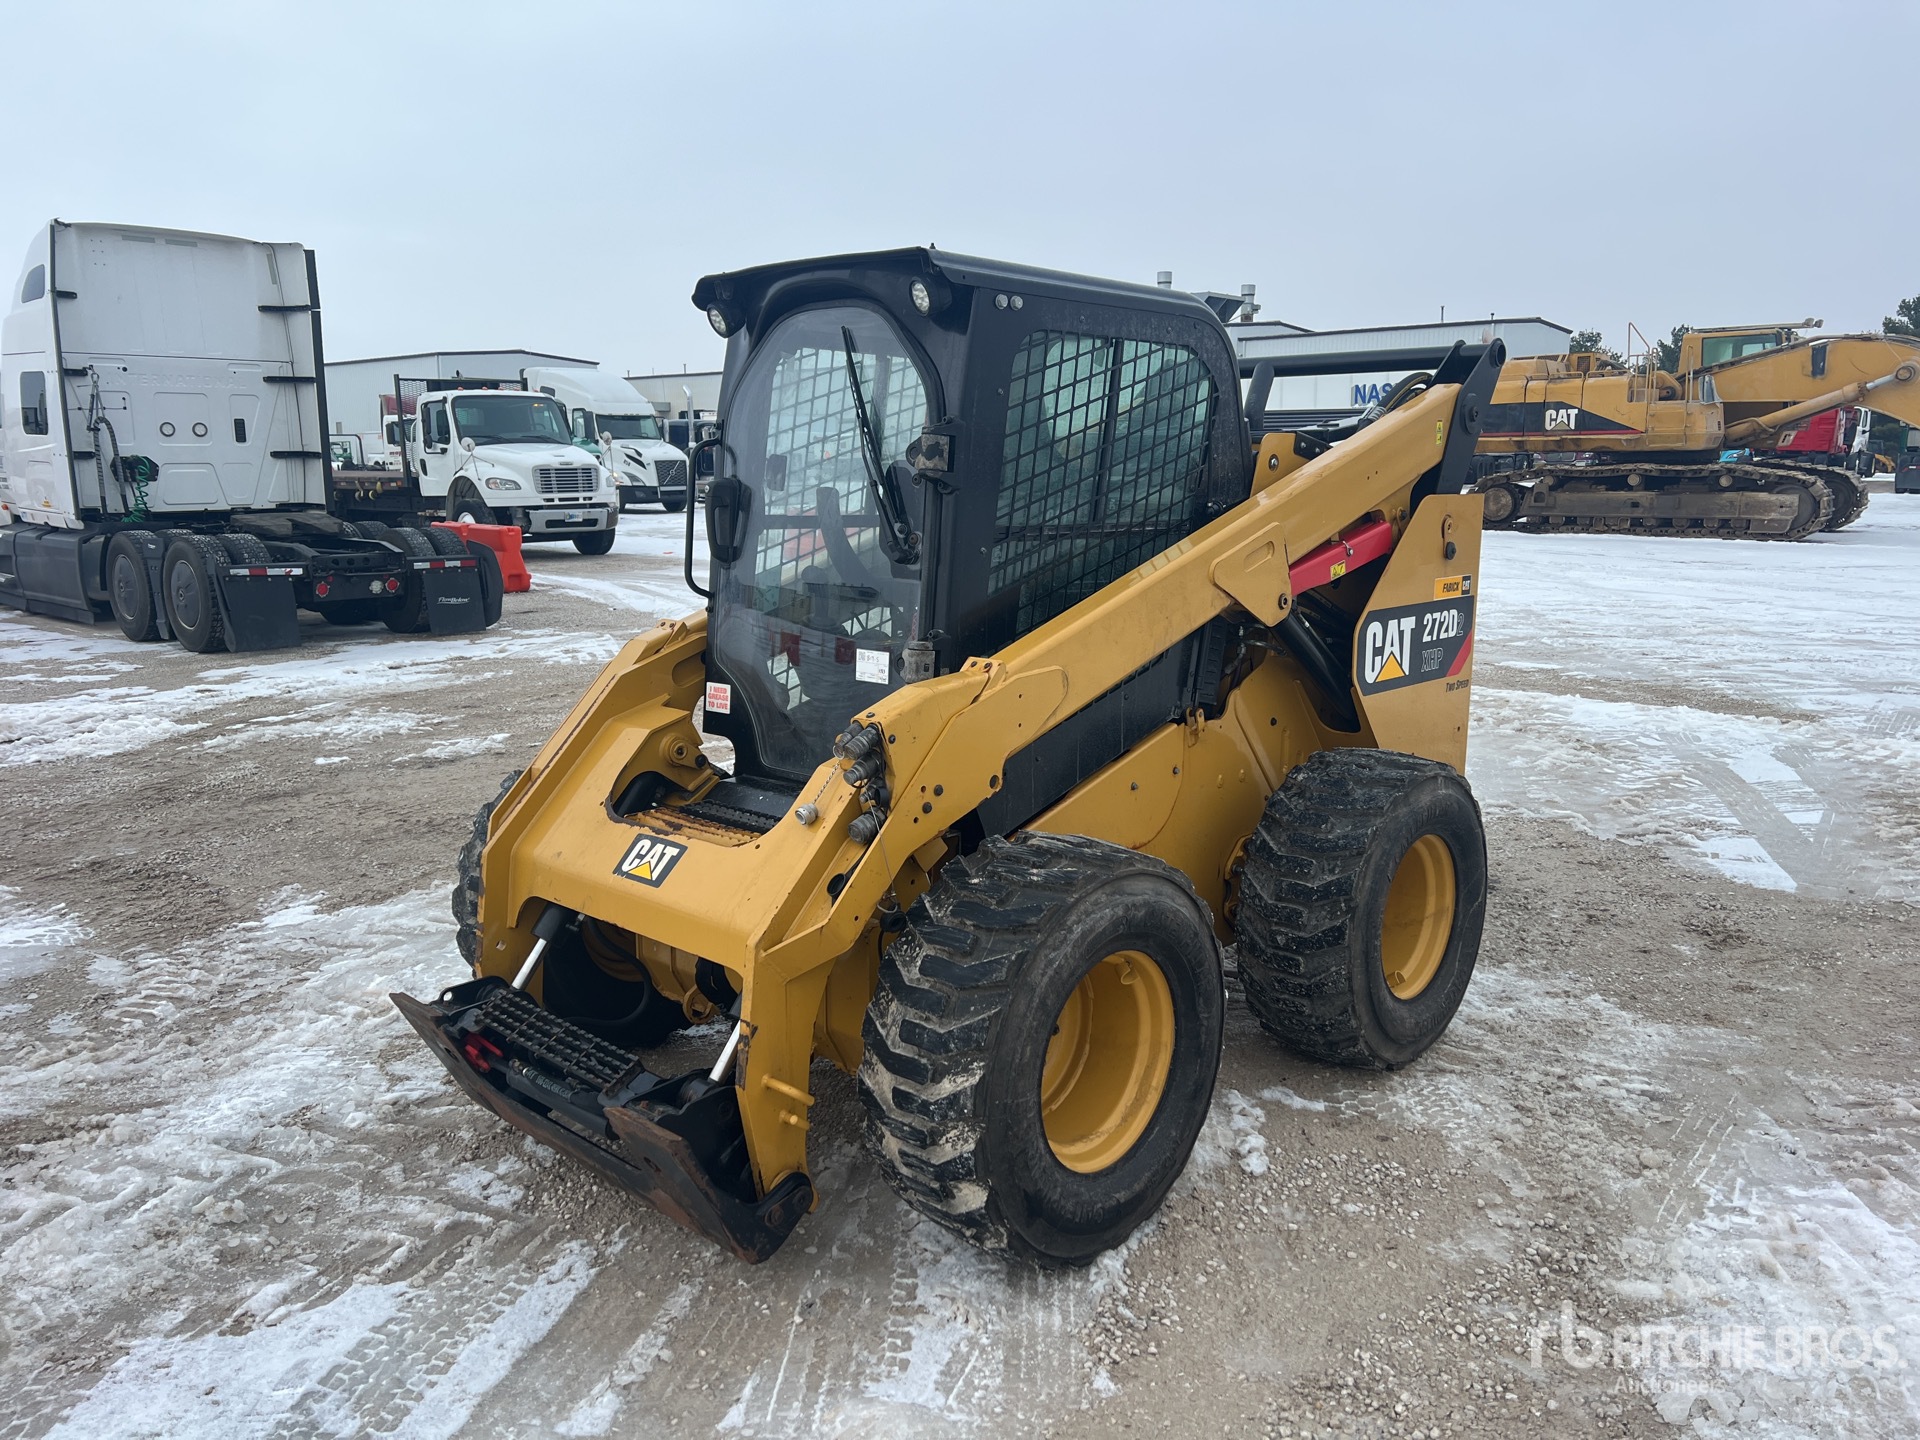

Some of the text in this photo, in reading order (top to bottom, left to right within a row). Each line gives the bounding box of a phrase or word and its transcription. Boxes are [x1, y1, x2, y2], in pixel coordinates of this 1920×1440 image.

[1544, 408, 1578, 431] CAT
[1462, 580, 1470, 591] CAT
[1364, 616, 1416, 684] CAT
[1421, 647, 1444, 672] XHP
[708, 692, 729, 702] GREASE
[713, 686, 727, 694] NEED
[708, 700, 728, 710] TO LIVE
[621, 838, 680, 881] CAT
